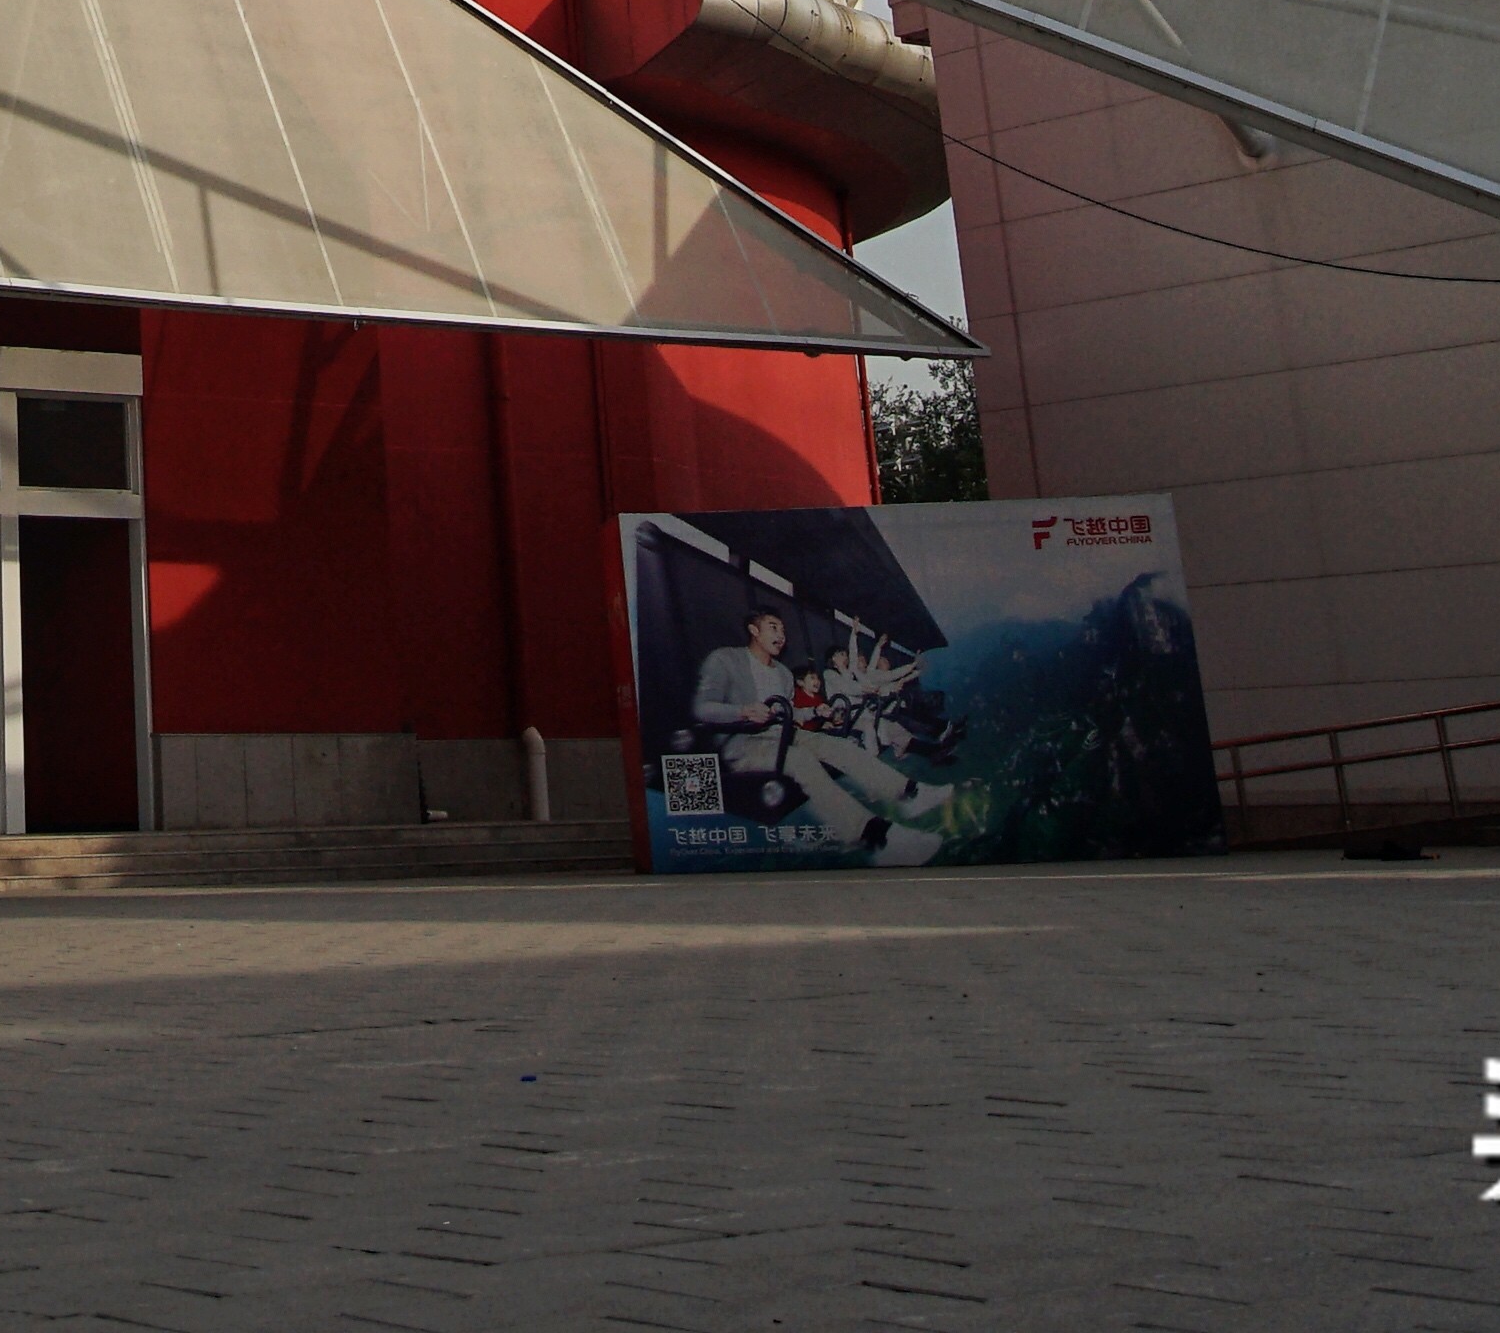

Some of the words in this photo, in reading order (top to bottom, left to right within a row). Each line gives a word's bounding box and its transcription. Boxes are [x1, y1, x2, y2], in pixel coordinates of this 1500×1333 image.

[1063, 516, 1151, 535] 飞越中国
[1067, 537, 1117, 546] FLYOVER
[1119, 535, 1152, 545] CHINA
[668, 826, 747, 845] 飞越中国
